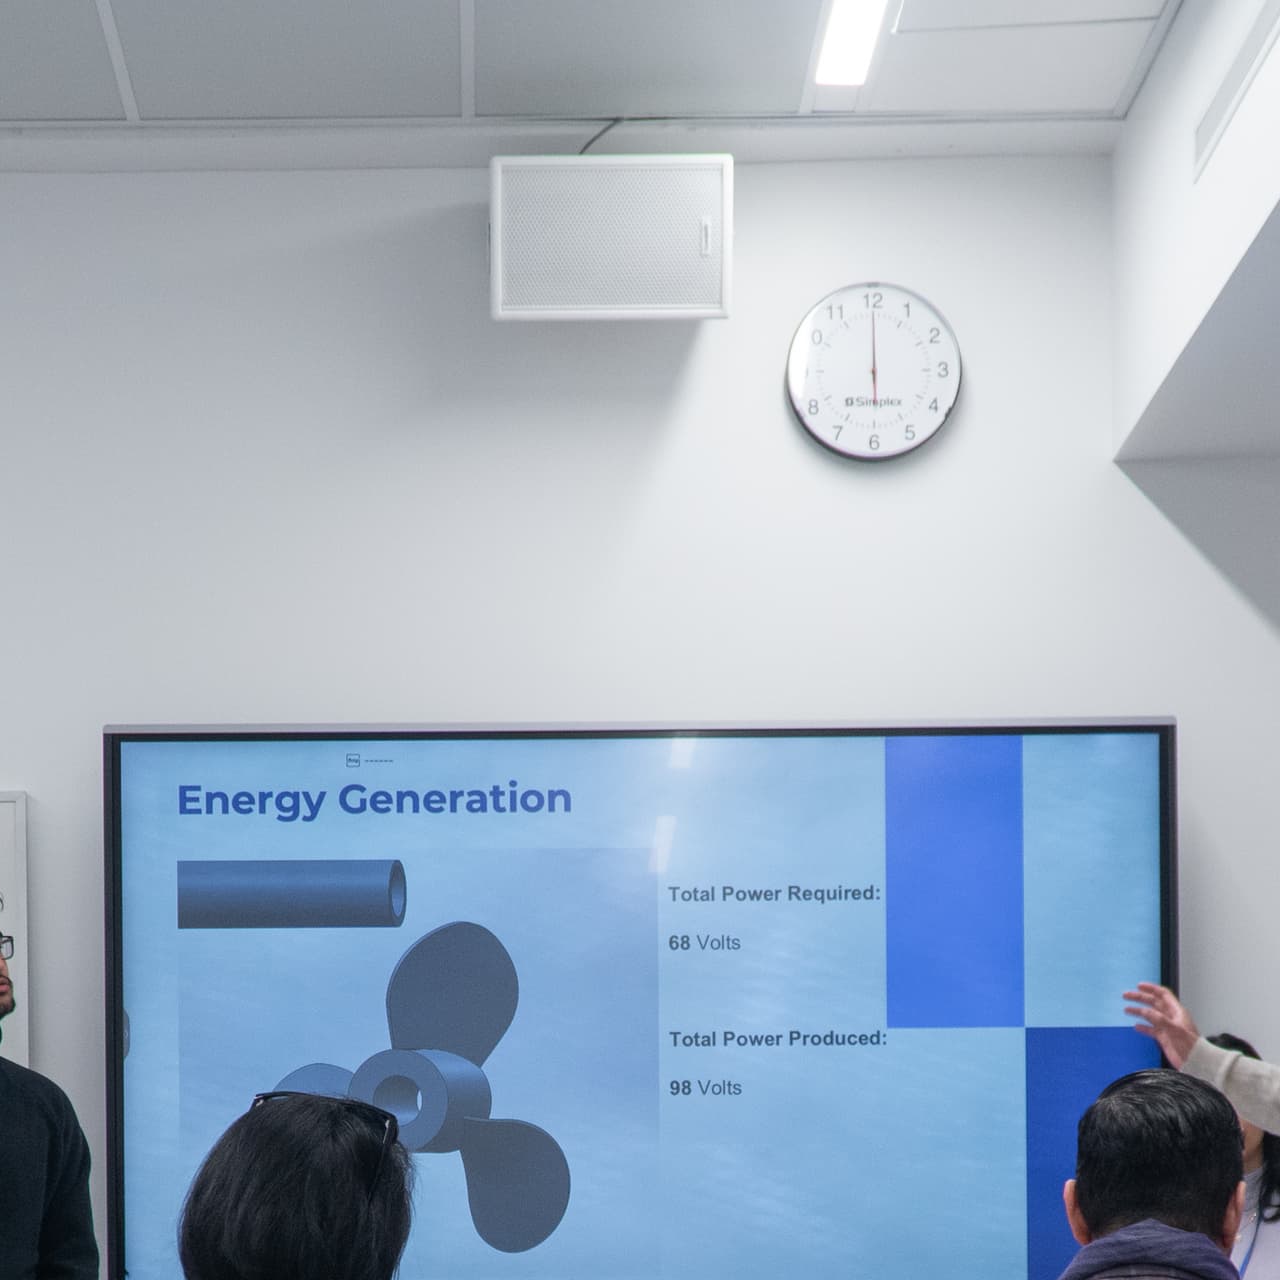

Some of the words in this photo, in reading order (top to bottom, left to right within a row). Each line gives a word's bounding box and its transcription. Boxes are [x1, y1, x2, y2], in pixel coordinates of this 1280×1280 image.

[863, 292, 883, 309] 12
[826, 303, 844, 320] 11
[903, 302, 911, 318] 1
[929, 327, 941, 344] 2
[937, 361, 950, 378] 3
[807, 399, 820, 416] 8
[928, 397, 939, 413] 4
[832, 425, 844, 441] 7
[904, 424, 917, 441] 5
[869, 434, 881, 451] 6
[178, 784, 327, 823] Energy
[338, 779, 572, 815] Generation
[667, 886, 716, 902] Total
[722, 885, 783, 902] Power
[787, 884, 881, 905] Required:
[668, 934, 691, 951] 68
[696, 934, 741, 951] Volts
[668, 1031, 717, 1048] Total
[723, 1031, 784, 1047] Power
[789, 1030, 888, 1047] Produced:
[669, 1079, 692, 1097] 98
[697, 1079, 743, 1096] Volts
